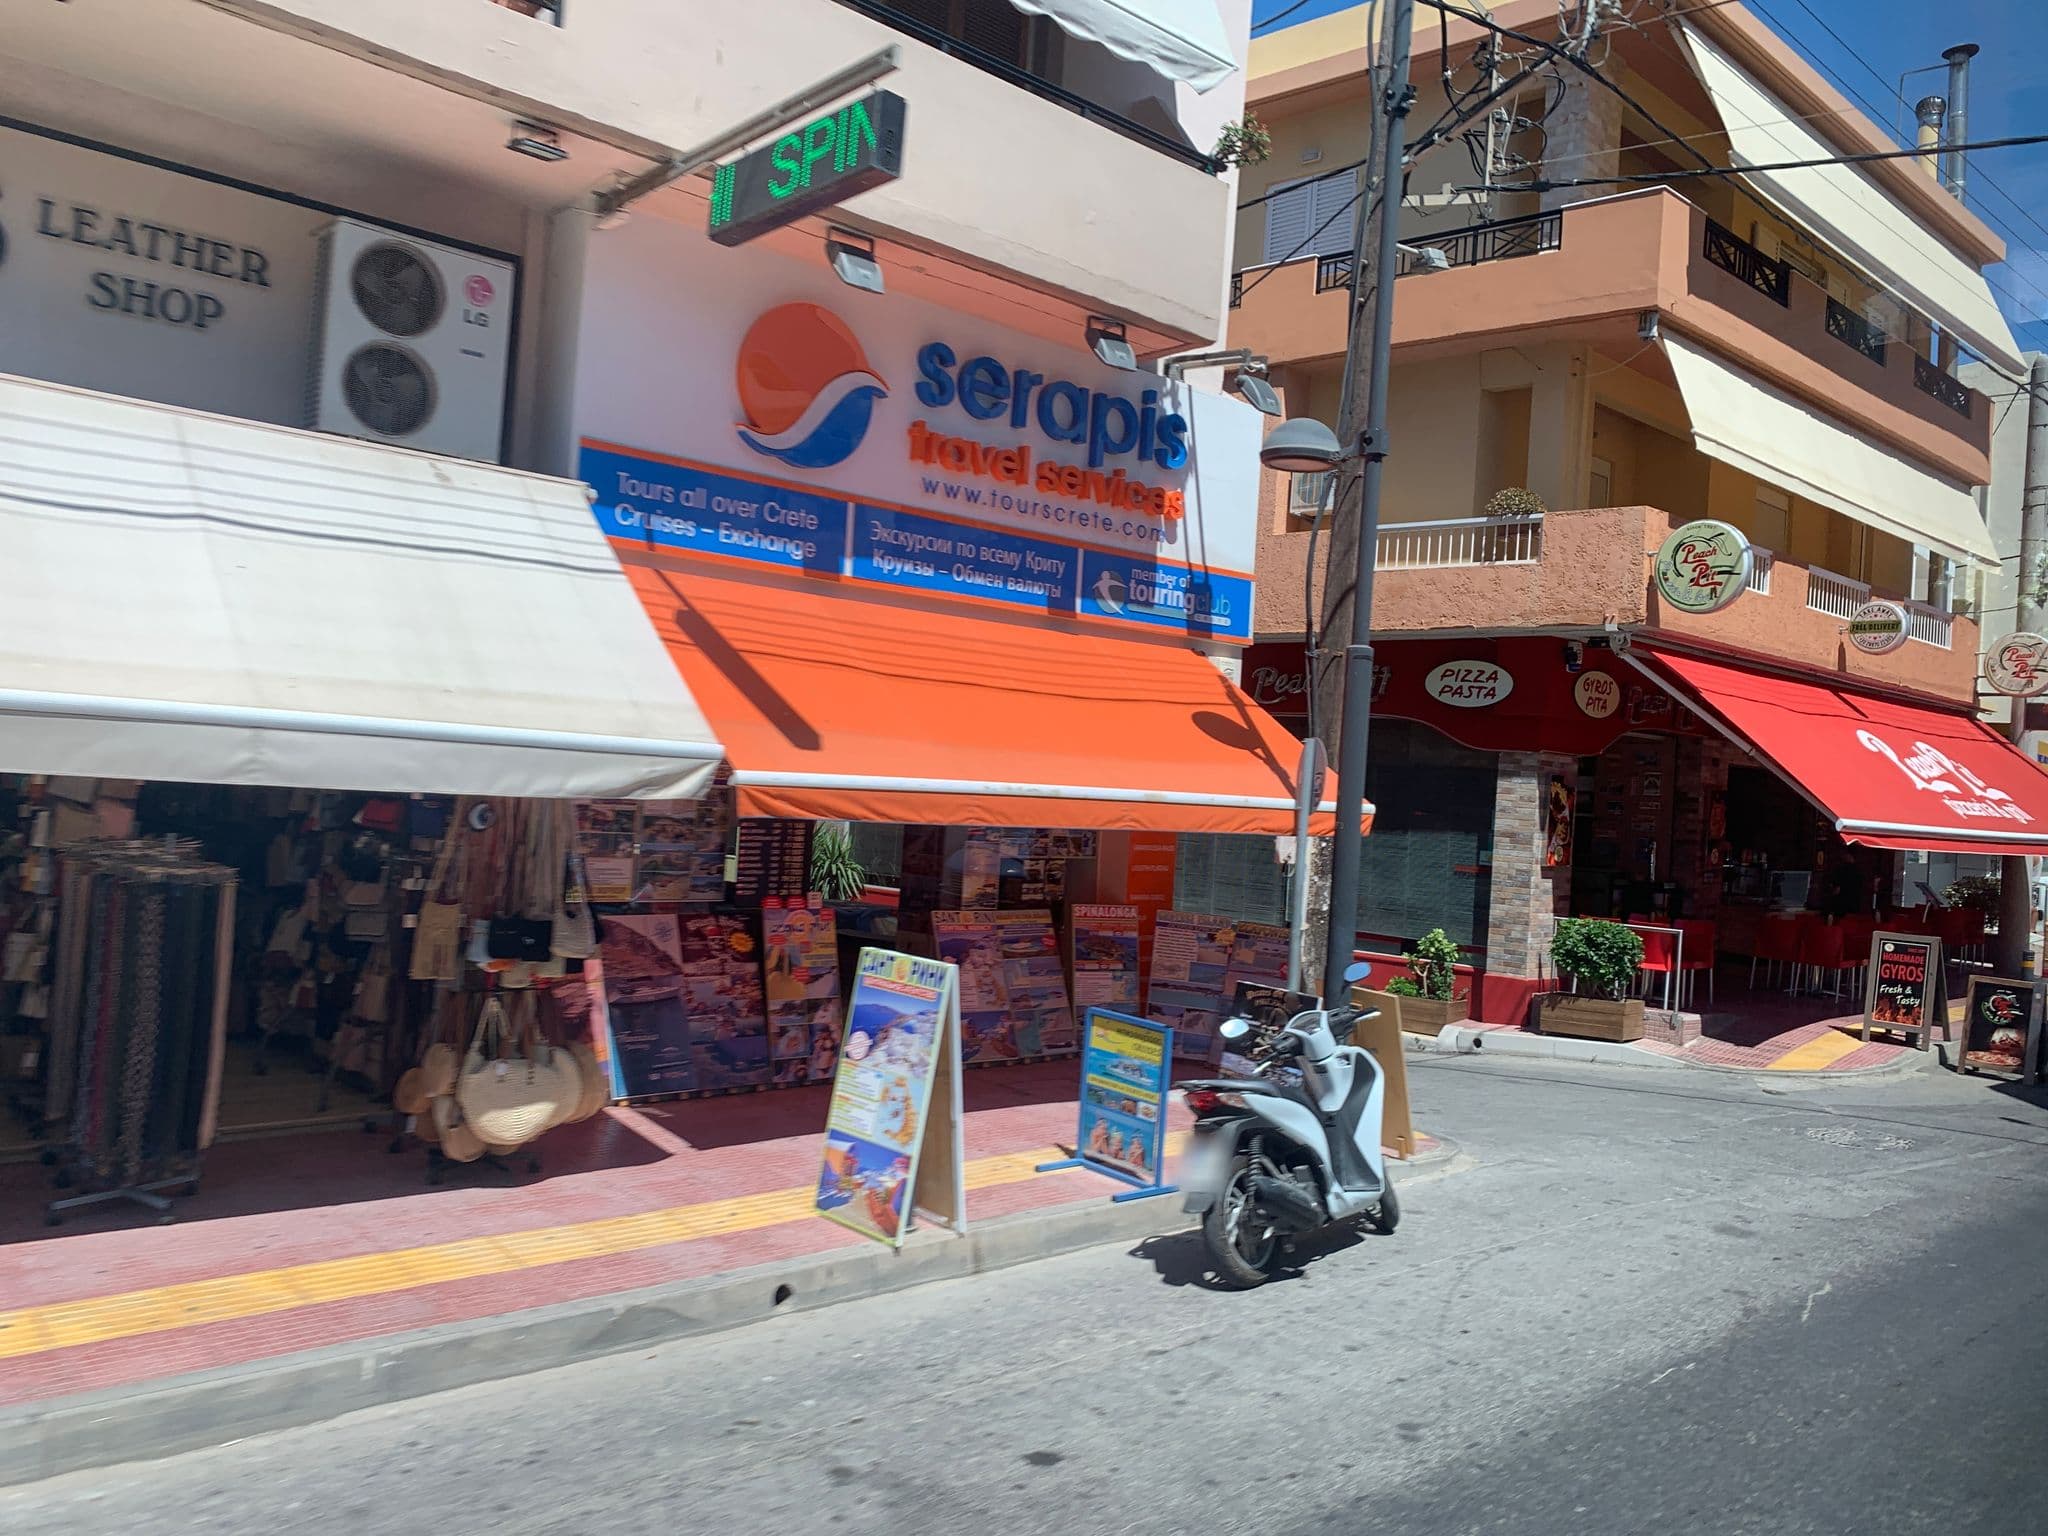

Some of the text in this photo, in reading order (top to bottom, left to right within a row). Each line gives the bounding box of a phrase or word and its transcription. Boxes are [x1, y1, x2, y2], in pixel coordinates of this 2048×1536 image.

[36, 197, 272, 288] LEATHER
[86, 271, 226, 330] SHOP
[463, 308, 490, 328] LG
[914, 341, 1189, 470] serapis
[907, 419, 1185, 520] travel services
[616, 470, 819, 531] Tours all over Crete
[922, 475, 1166, 545] www.tourscrete.com
[614, 503, 697, 538] Cruises
[718, 521, 817, 560] Exchange
[869, 520, 1066, 578] Экскурсии по всему Криту
[1680, 543, 1718, 564] Peach
[872, 548, 935, 576] Круизы
[952, 562, 1003, 588] Обмен
[1007, 575, 1062, 598] валюты
[1131, 568, 1192, 588] member of
[1689, 562, 1724, 588] Pit
[1440, 668, 1499, 683] PIZZA
[1438, 684, 1497, 700] PASTA
[1583, 677, 1614, 696] GYROS
[1585, 697, 1608, 712] PITA
[1883, 951, 1926, 964] HOMEMADE
[1881, 963, 1924, 982] GYROS
[1880, 984, 1912, 994] Fresh &
[1896, 995, 1920, 1008] Tasty
